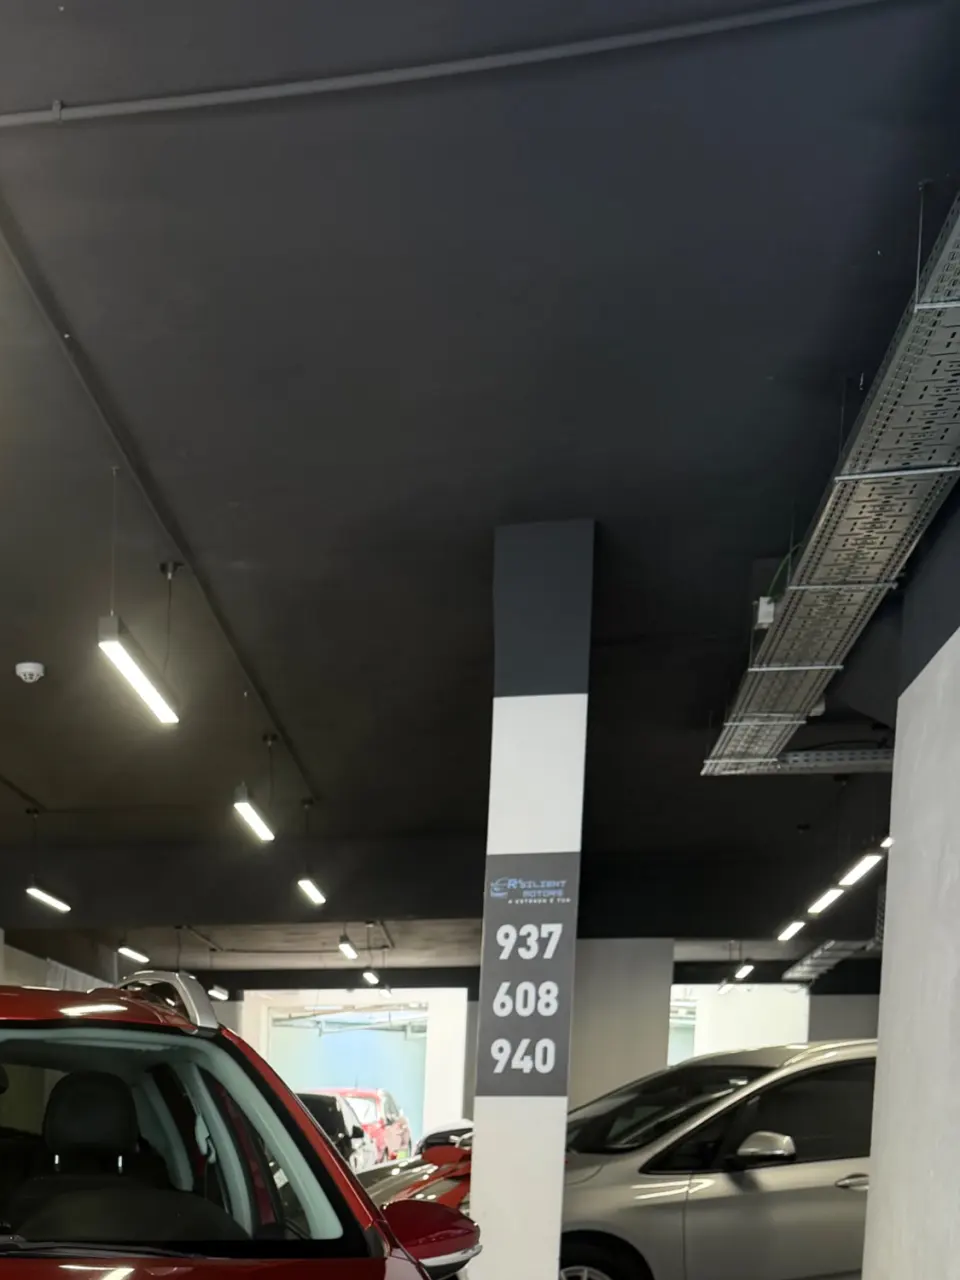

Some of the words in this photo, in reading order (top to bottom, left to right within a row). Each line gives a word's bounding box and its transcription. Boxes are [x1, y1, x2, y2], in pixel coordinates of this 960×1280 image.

[496, 923, 563, 960] 937
[492, 981, 559, 1017] 608
[490, 1038, 556, 1074] 940
